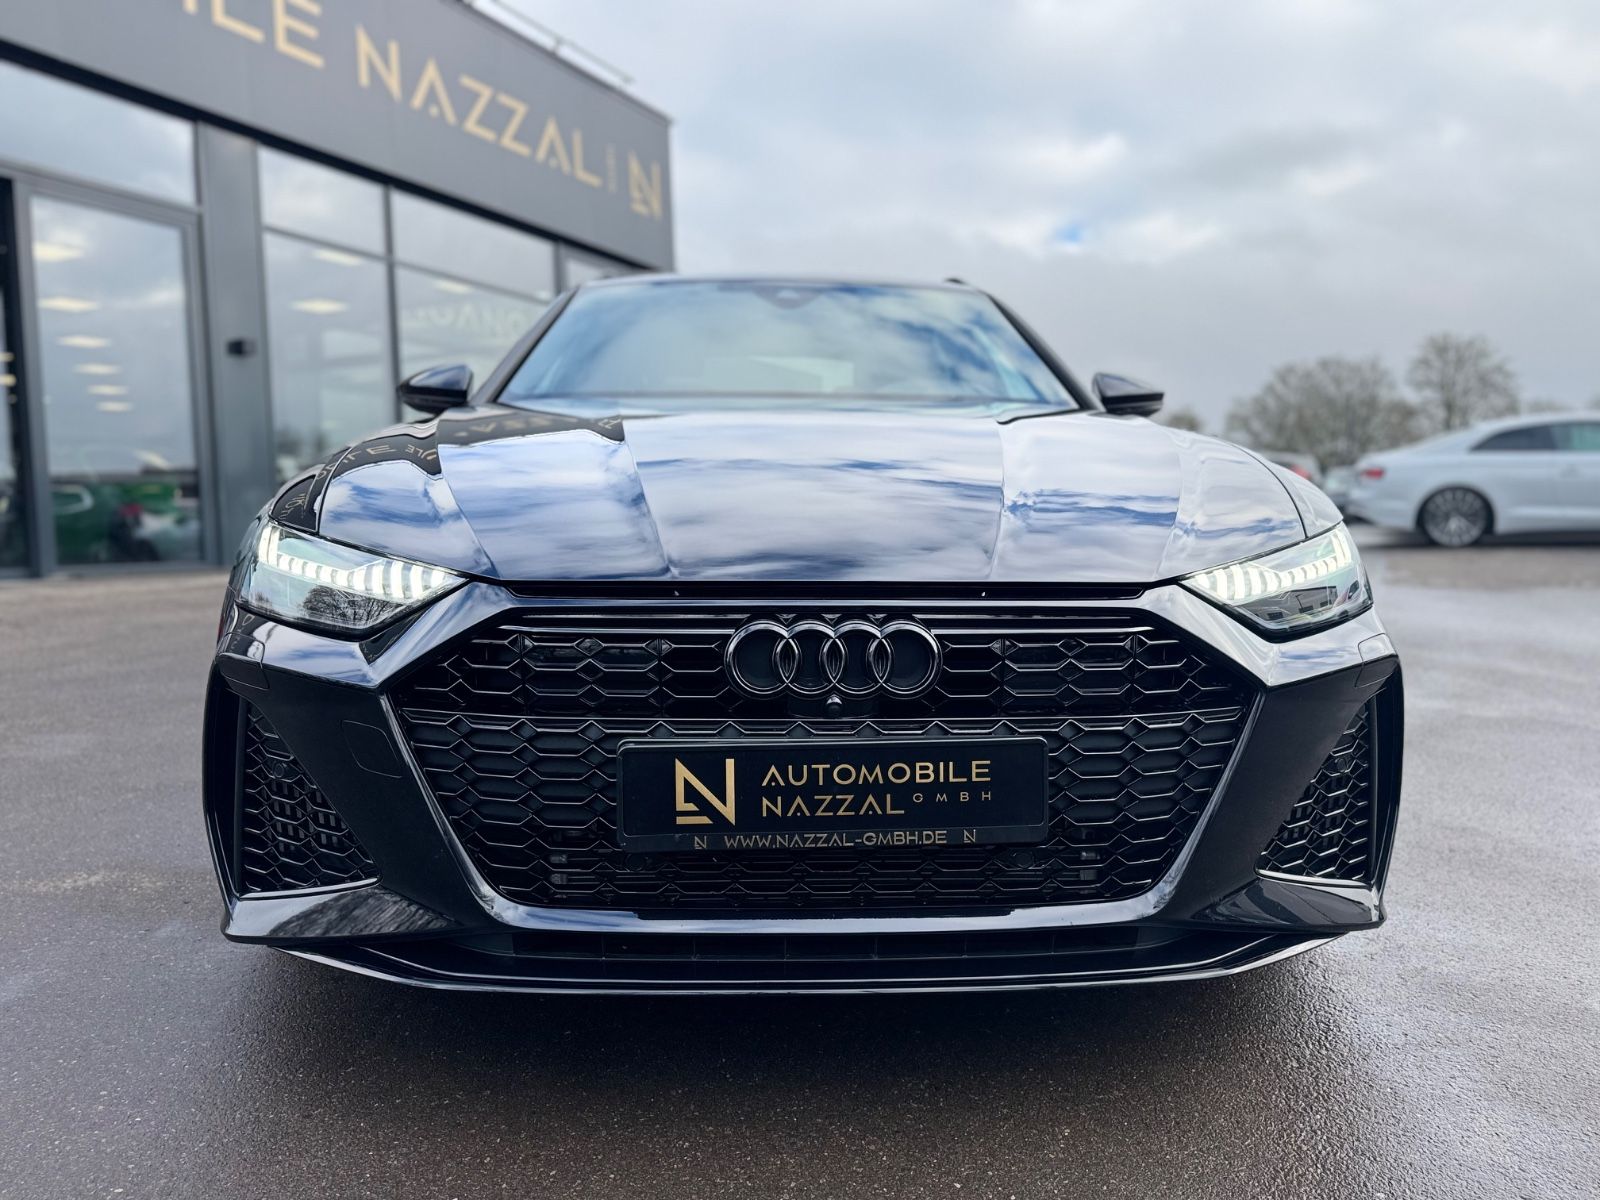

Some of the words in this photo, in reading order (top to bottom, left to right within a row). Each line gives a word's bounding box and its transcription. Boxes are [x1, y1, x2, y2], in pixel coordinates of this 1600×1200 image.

[355, 24, 602, 188] NAZZAL
[761, 760, 991, 786] AUTOMOBILE
[762, 793, 905, 817] NAZZAL
[913, 791, 992, 803] GMBH
[724, 830, 947, 849] WWW.NAZZAL-GMBH.DE
